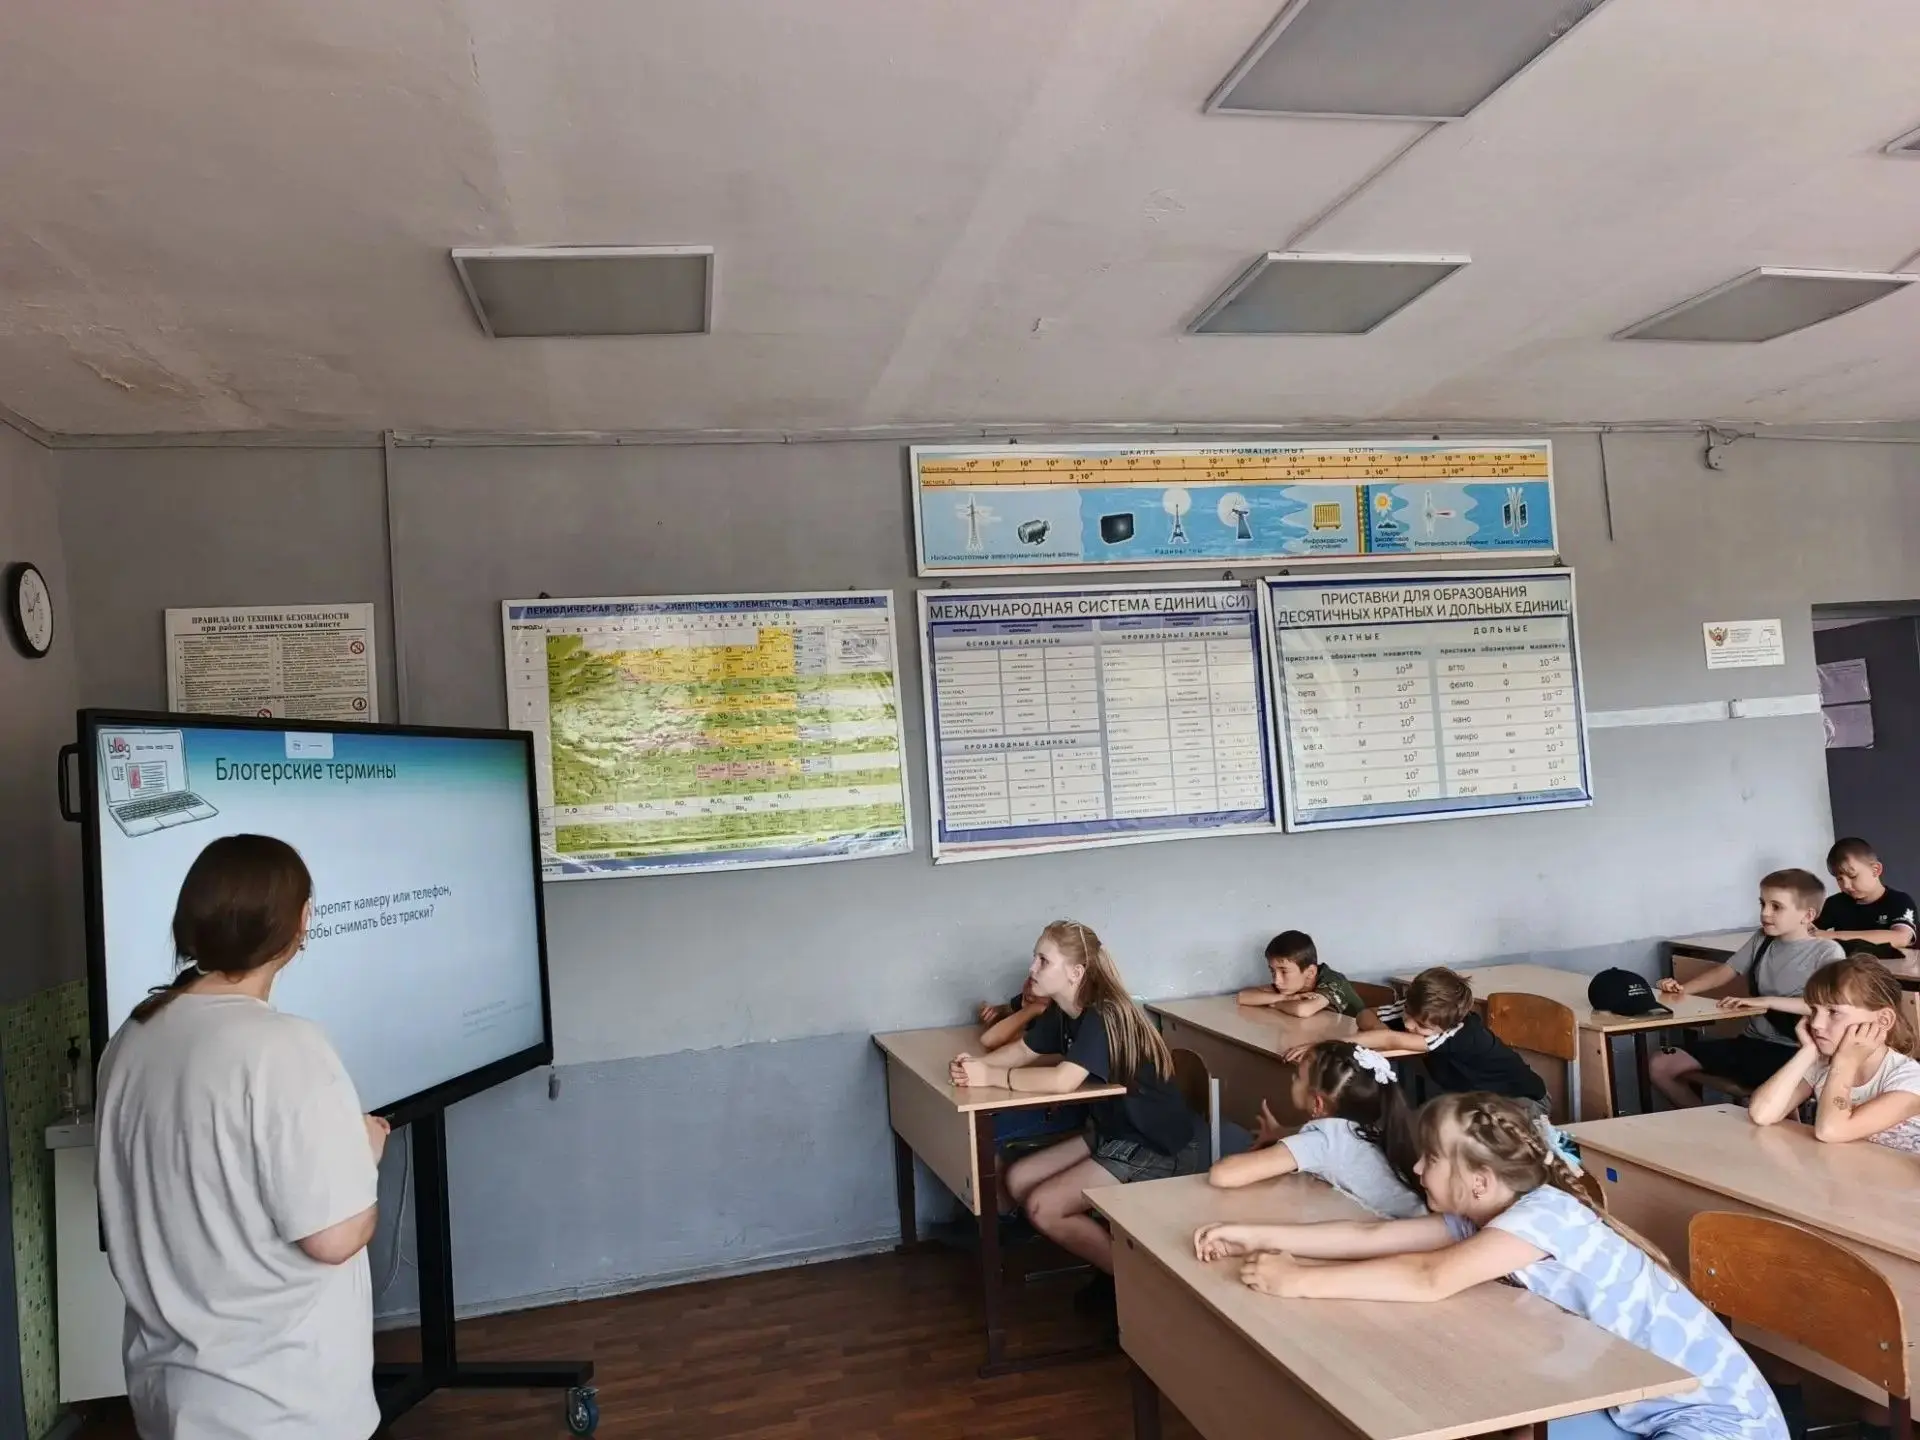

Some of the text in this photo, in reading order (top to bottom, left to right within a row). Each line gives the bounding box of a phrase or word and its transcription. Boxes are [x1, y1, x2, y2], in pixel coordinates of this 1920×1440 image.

[1321, 585, 1527, 605] ПРИСТАВКИ ДЛЯ ОБРАЗОВАНИЯ
[527, 604, 610, 615] ПЕРИОДИЧЕСКАЯ
[616, 603, 661, 613] СИСТЕМА
[665, 601, 728, 612] ХИМИЧЕСКИХ
[733, 599, 788, 609] ЭЛЕМЕНТОВ
[816, 597, 876, 606] МЕНДЕЛЕЕВА
[930, 601, 1073, 619] МЕЖДУНАРОДНАЯ
[1078, 600, 1150, 613] СИСТЕМА
[1154, 596, 1217, 611] ЕДИНИЦ
[1278, 607, 1370, 625] ДЕСЯТИЧНЫХ
[1373, 605, 1434, 621] КРАТНЫХ
[1437, 604, 1446, 616] И
[1450, 602, 1512, 617] ДОЛЬНЫХ
[192, 612, 349, 625] ПРАВИЛА ПО ТЕХНИКЕ БЕЗОПАСНОСТИ
[218, 624, 246, 633] работе
[256, 623, 303, 631] химическом
[305, 621, 341, 629] кабинете
[1325, 624, 1528, 642] КРАТНЫЕ ДОЛЬНЫЕ
[108, 736, 131, 760] blog
[964, 739, 1076, 751] ПРОИЗВОДНЫЕ ЕДИНИЦЫ
[216, 757, 396, 785] Блогерские термины
[314, 884, 452, 919] крепят камеру или телефон,
[305, 904, 434, 941] тобы снимать без тряски?
